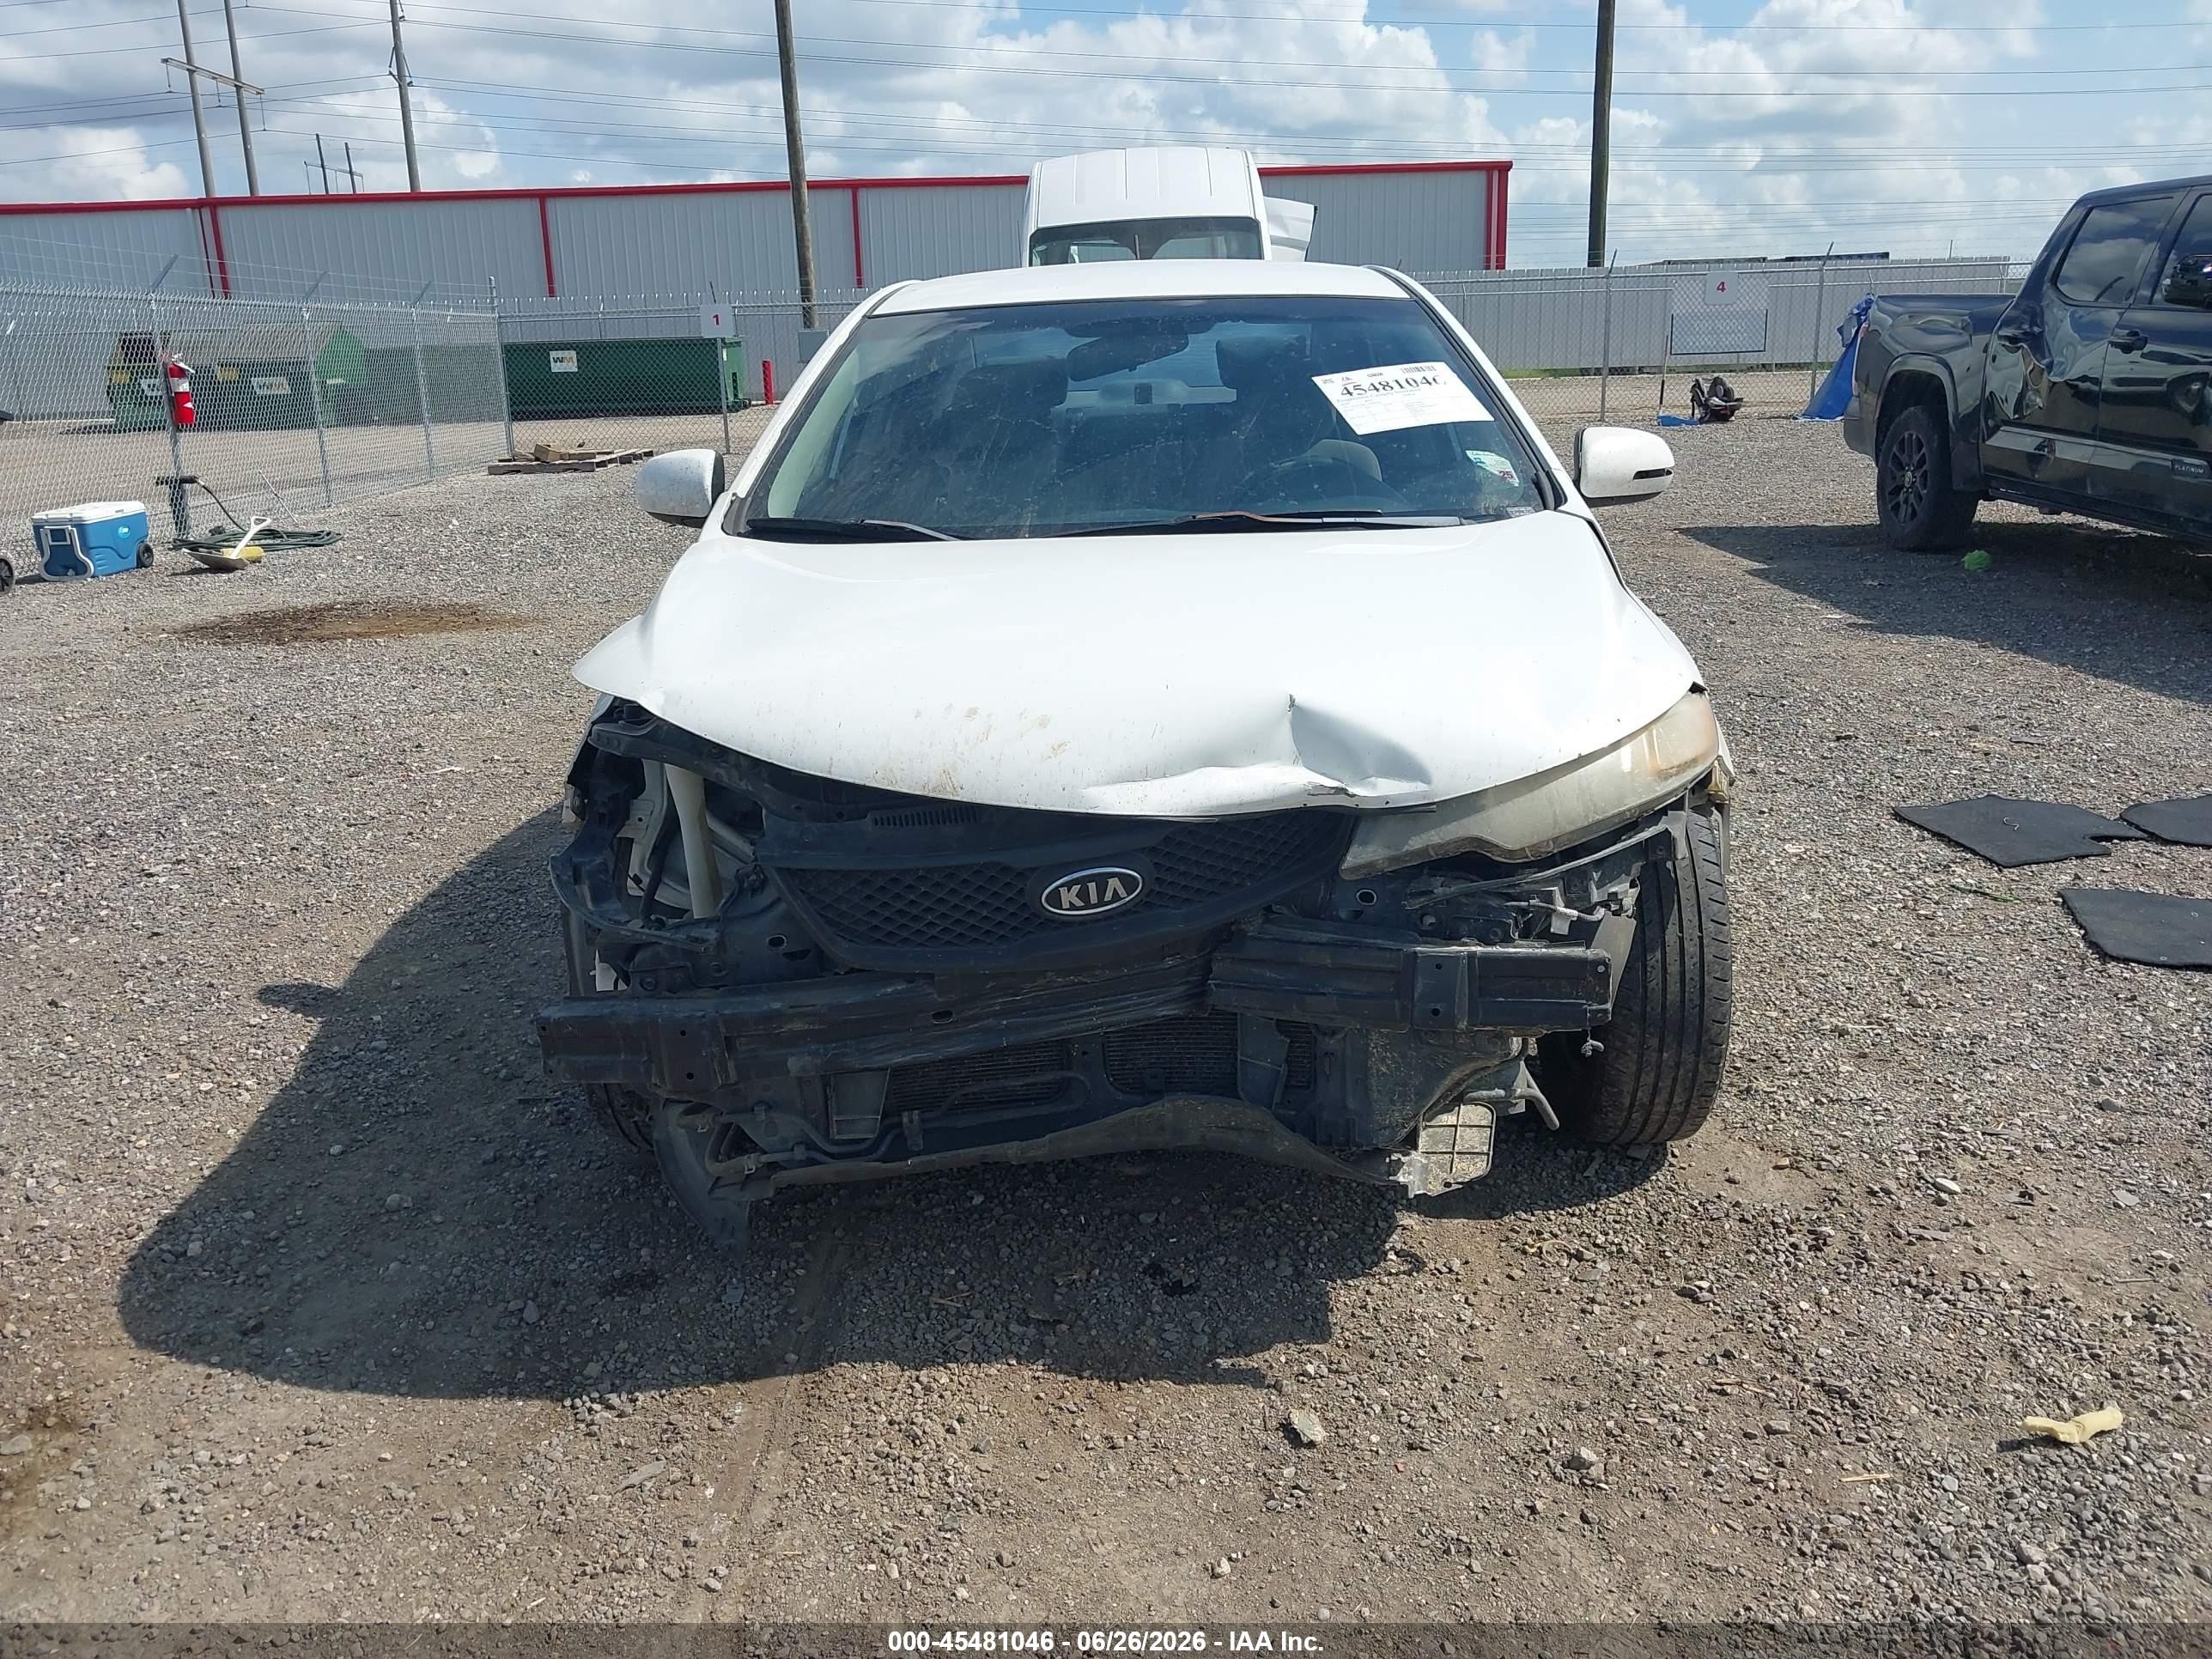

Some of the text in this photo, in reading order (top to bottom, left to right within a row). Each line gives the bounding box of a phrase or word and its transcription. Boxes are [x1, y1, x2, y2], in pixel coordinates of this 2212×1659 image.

[1717, 281, 1727, 293] 4
[713, 313, 720, 325] 1
[1498, 470, 1514, 479] 25
[1058, 877, 1127, 909] KIA
